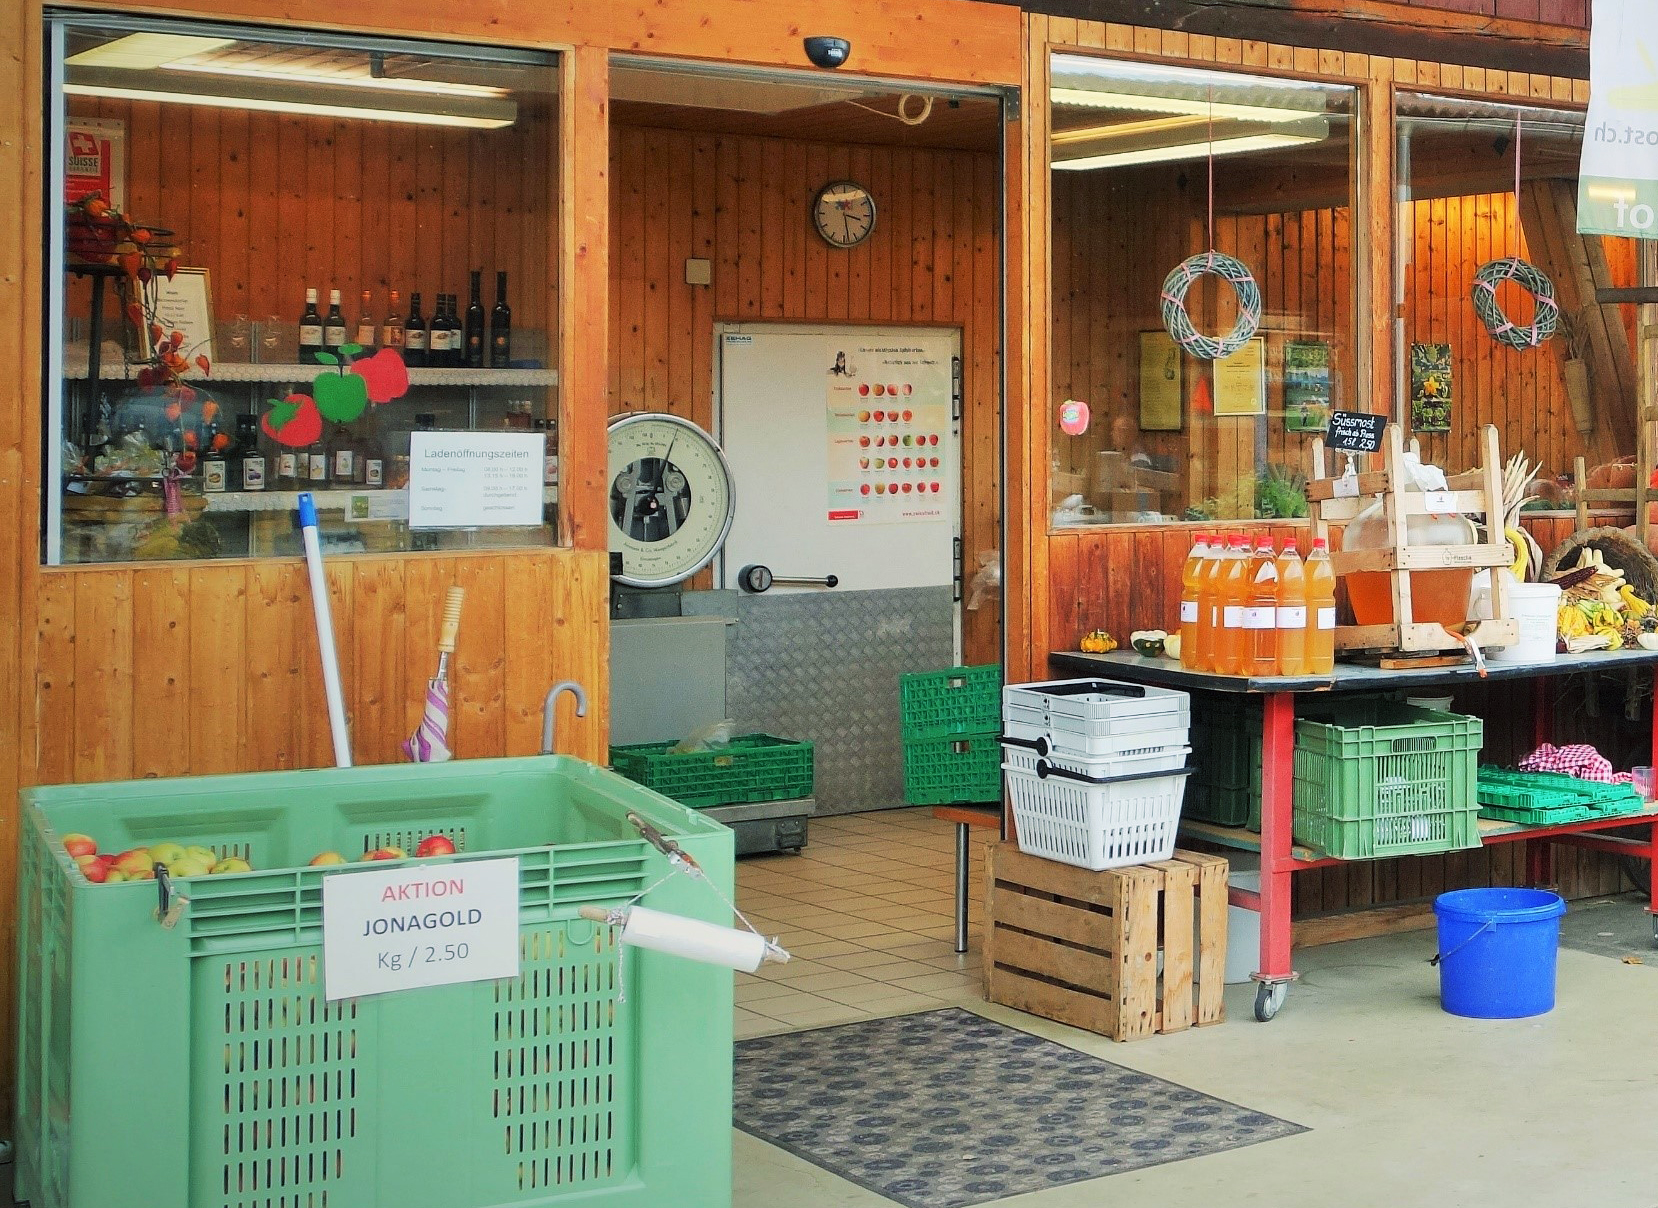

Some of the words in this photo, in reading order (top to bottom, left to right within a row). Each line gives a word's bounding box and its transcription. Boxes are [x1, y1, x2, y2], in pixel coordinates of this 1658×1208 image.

[68, 156, 98, 167] SUISSE
[1332, 413, 1376, 429] Süssmost
[424, 448, 529, 460] Ladenöffnungszeiten
[381, 879, 465, 903] AKTION
[363, 908, 482, 937] JONAGOLD
[378, 952, 402, 971] Kg
[408, 946, 418, 968] /
[425, 943, 469, 963] 2.50
